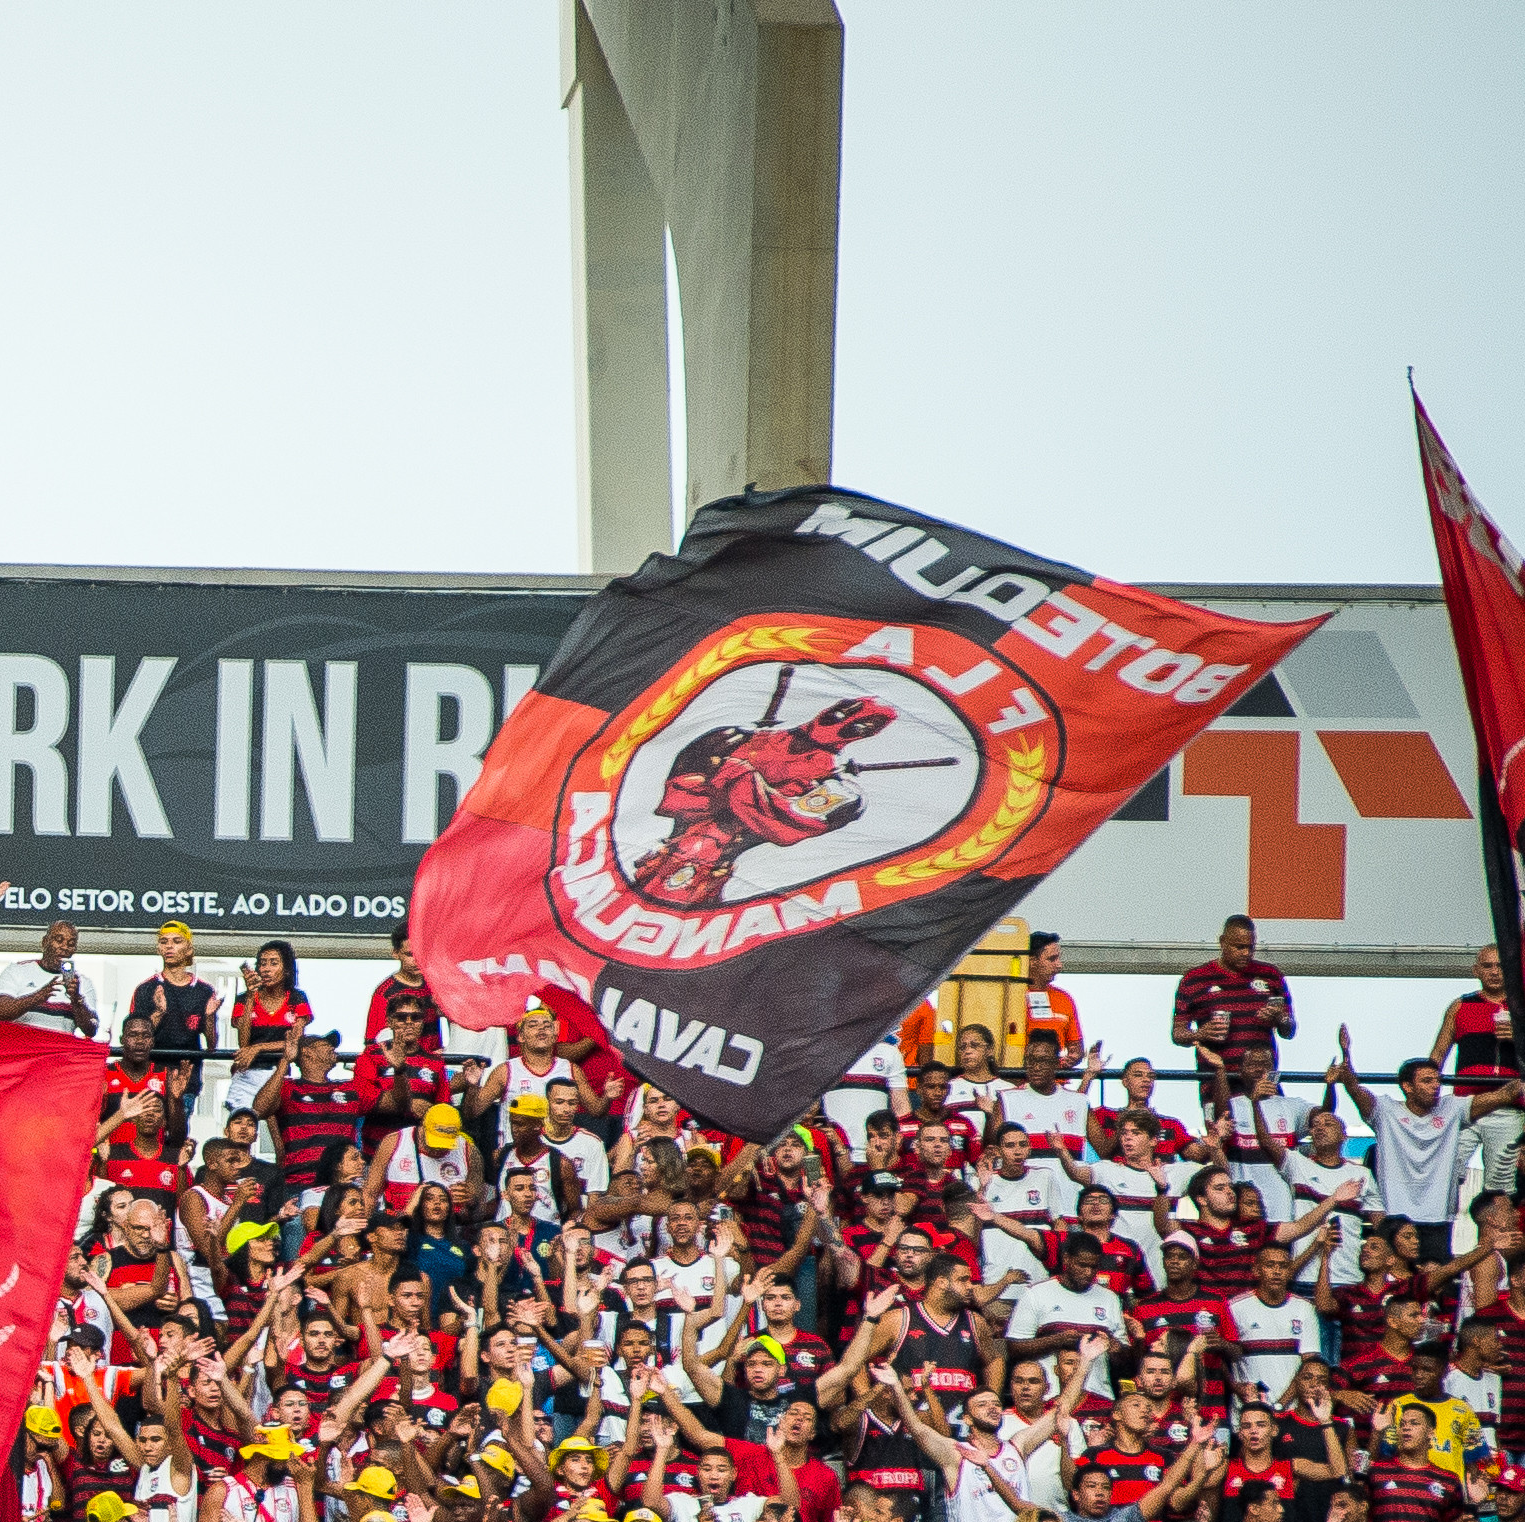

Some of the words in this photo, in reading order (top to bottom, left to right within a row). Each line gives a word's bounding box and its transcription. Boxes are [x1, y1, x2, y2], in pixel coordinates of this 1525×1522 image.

[212, 651, 360, 846] IN
[57, 889, 132, 914] SETOR
[141, 890, 226, 918] OESTE,
[231, 893, 271, 916] AO
[276, 893, 348, 917] LADO
[353, 895, 406, 919] DOS
